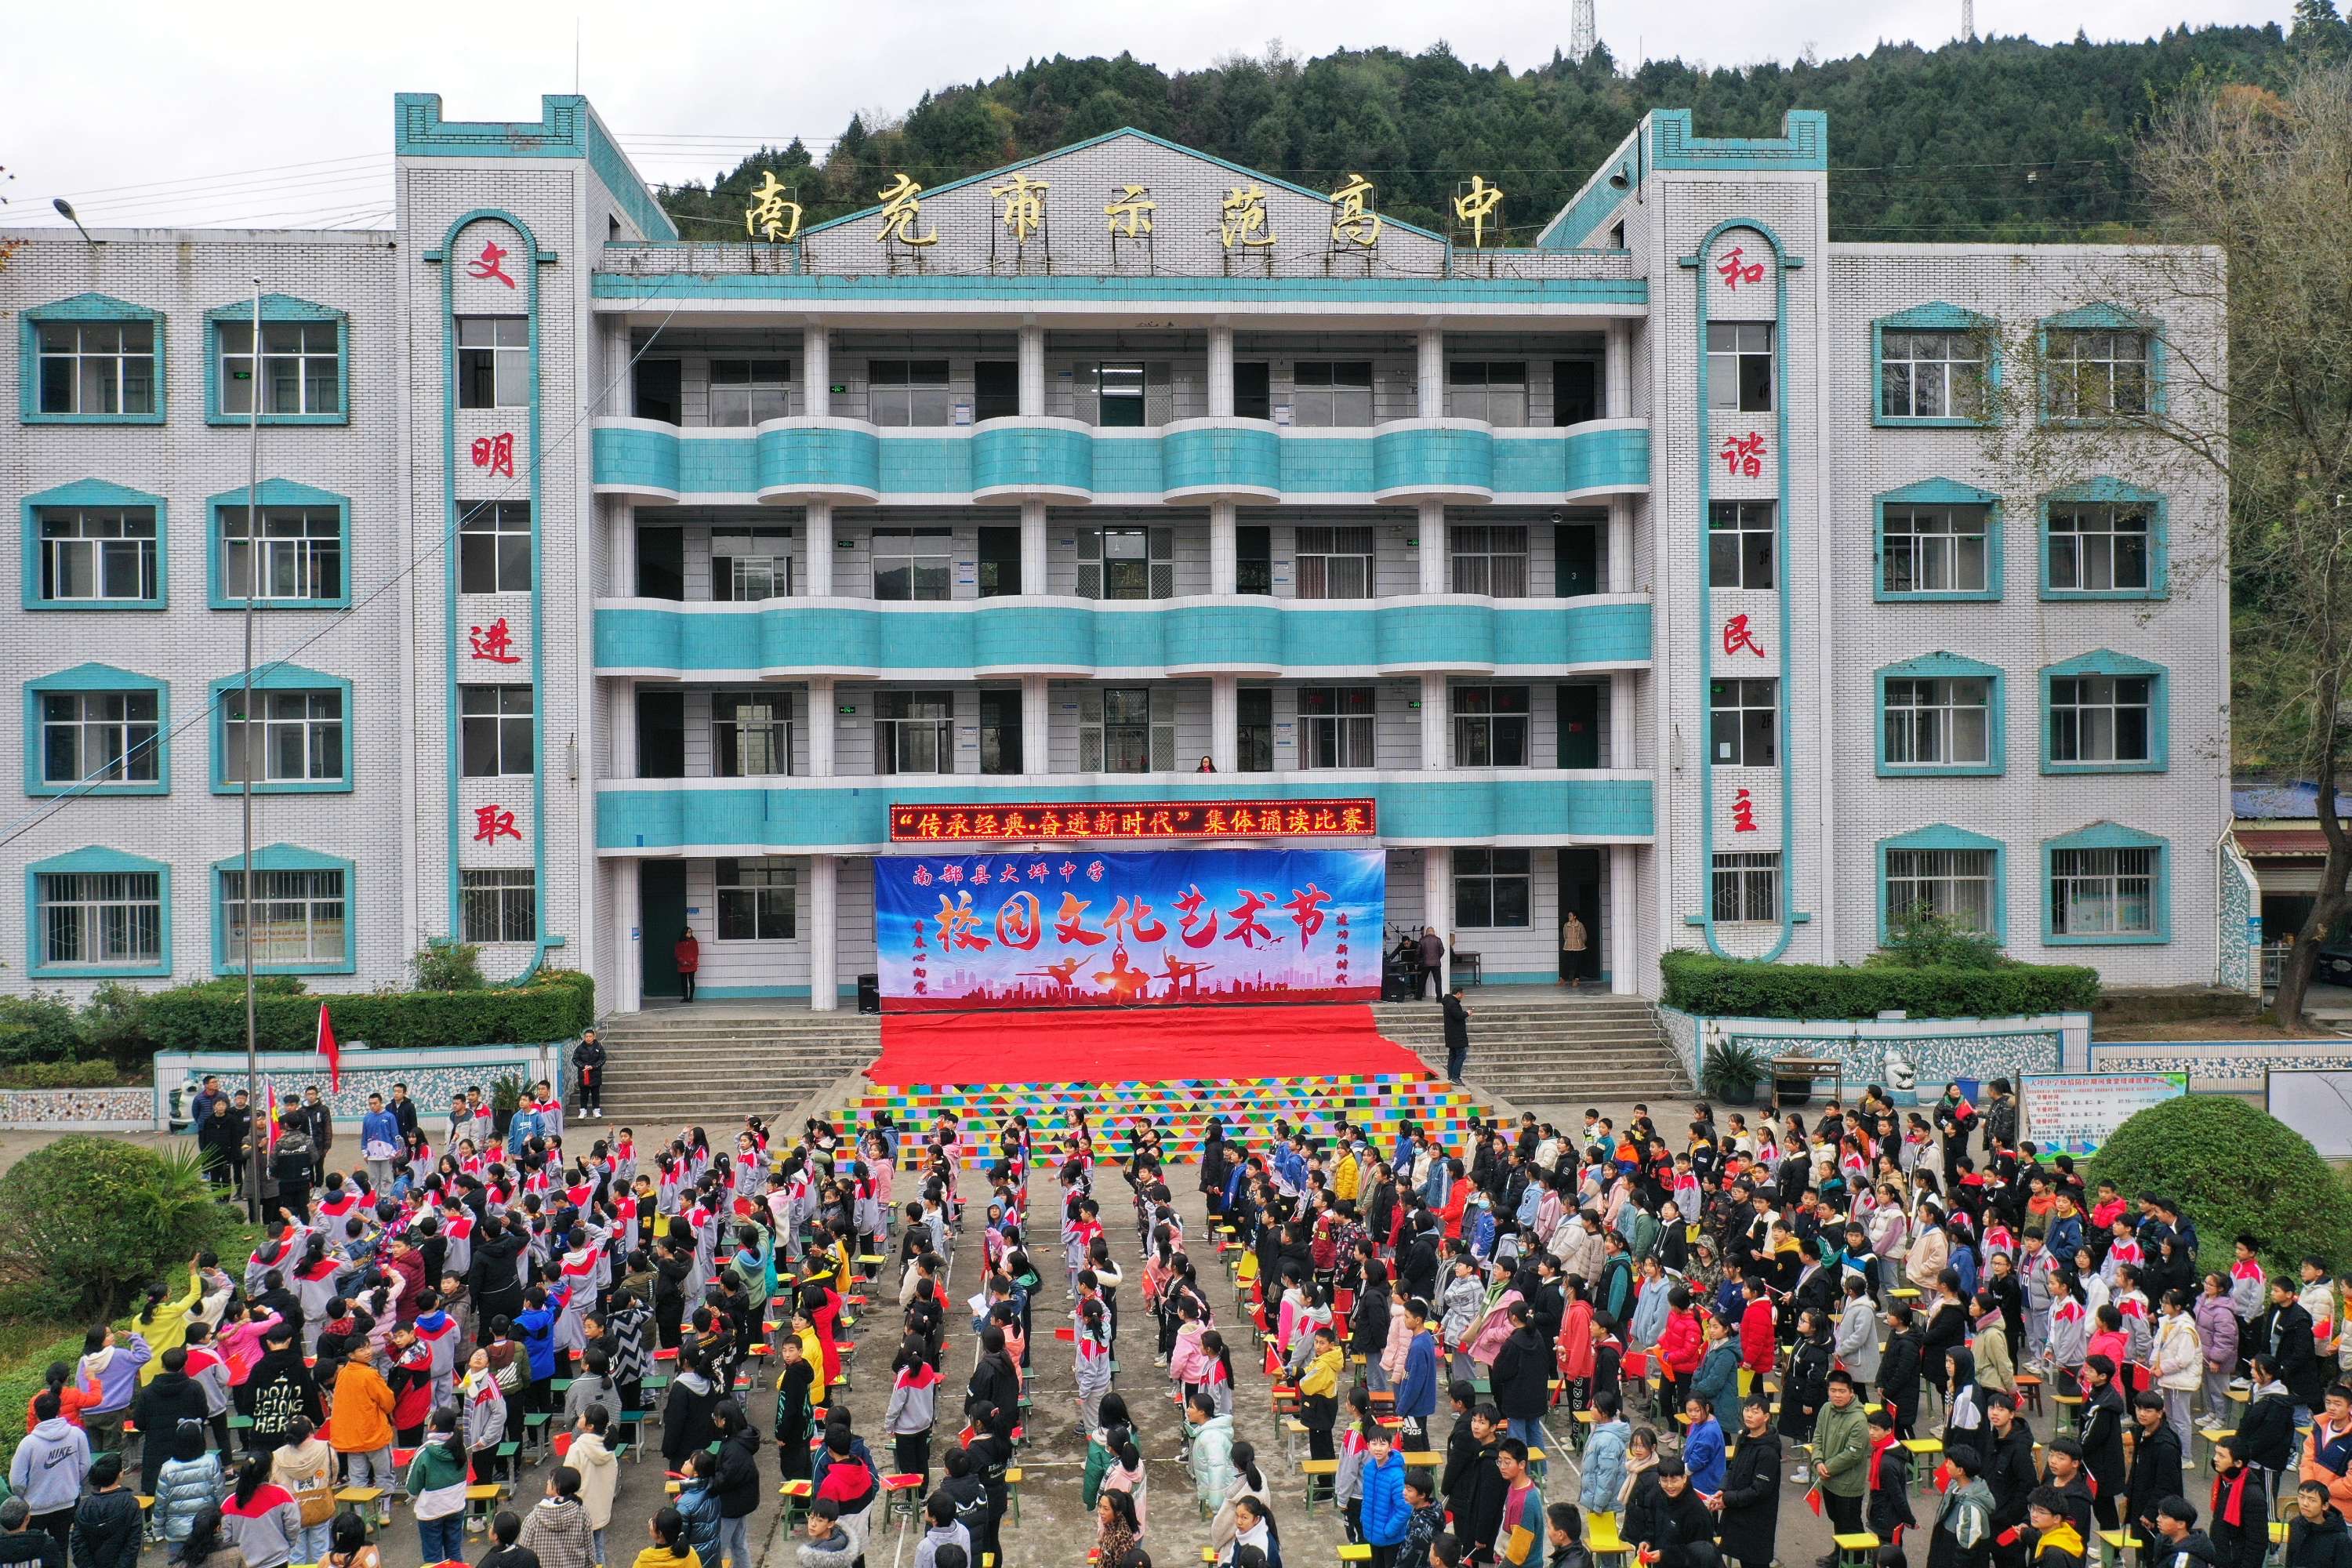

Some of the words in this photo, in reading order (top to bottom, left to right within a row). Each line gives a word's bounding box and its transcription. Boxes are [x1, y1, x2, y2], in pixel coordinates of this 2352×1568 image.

[746, 170, 1503, 247] 南充市示范高中
[466, 239, 521, 846] 文明进取
[1717, 246, 1767, 833] 和谐民主
[1761, 713, 1772, 728] 2F
[912, 861, 1105, 887] 南部县大坪中学
[935, 883, 1331, 953] 校园文化艺术节
[1335, 912, 1349, 985] 建功新时代
[48, 1446, 72, 1461] NIKE
[255, 1416, 290, 1433] HER
